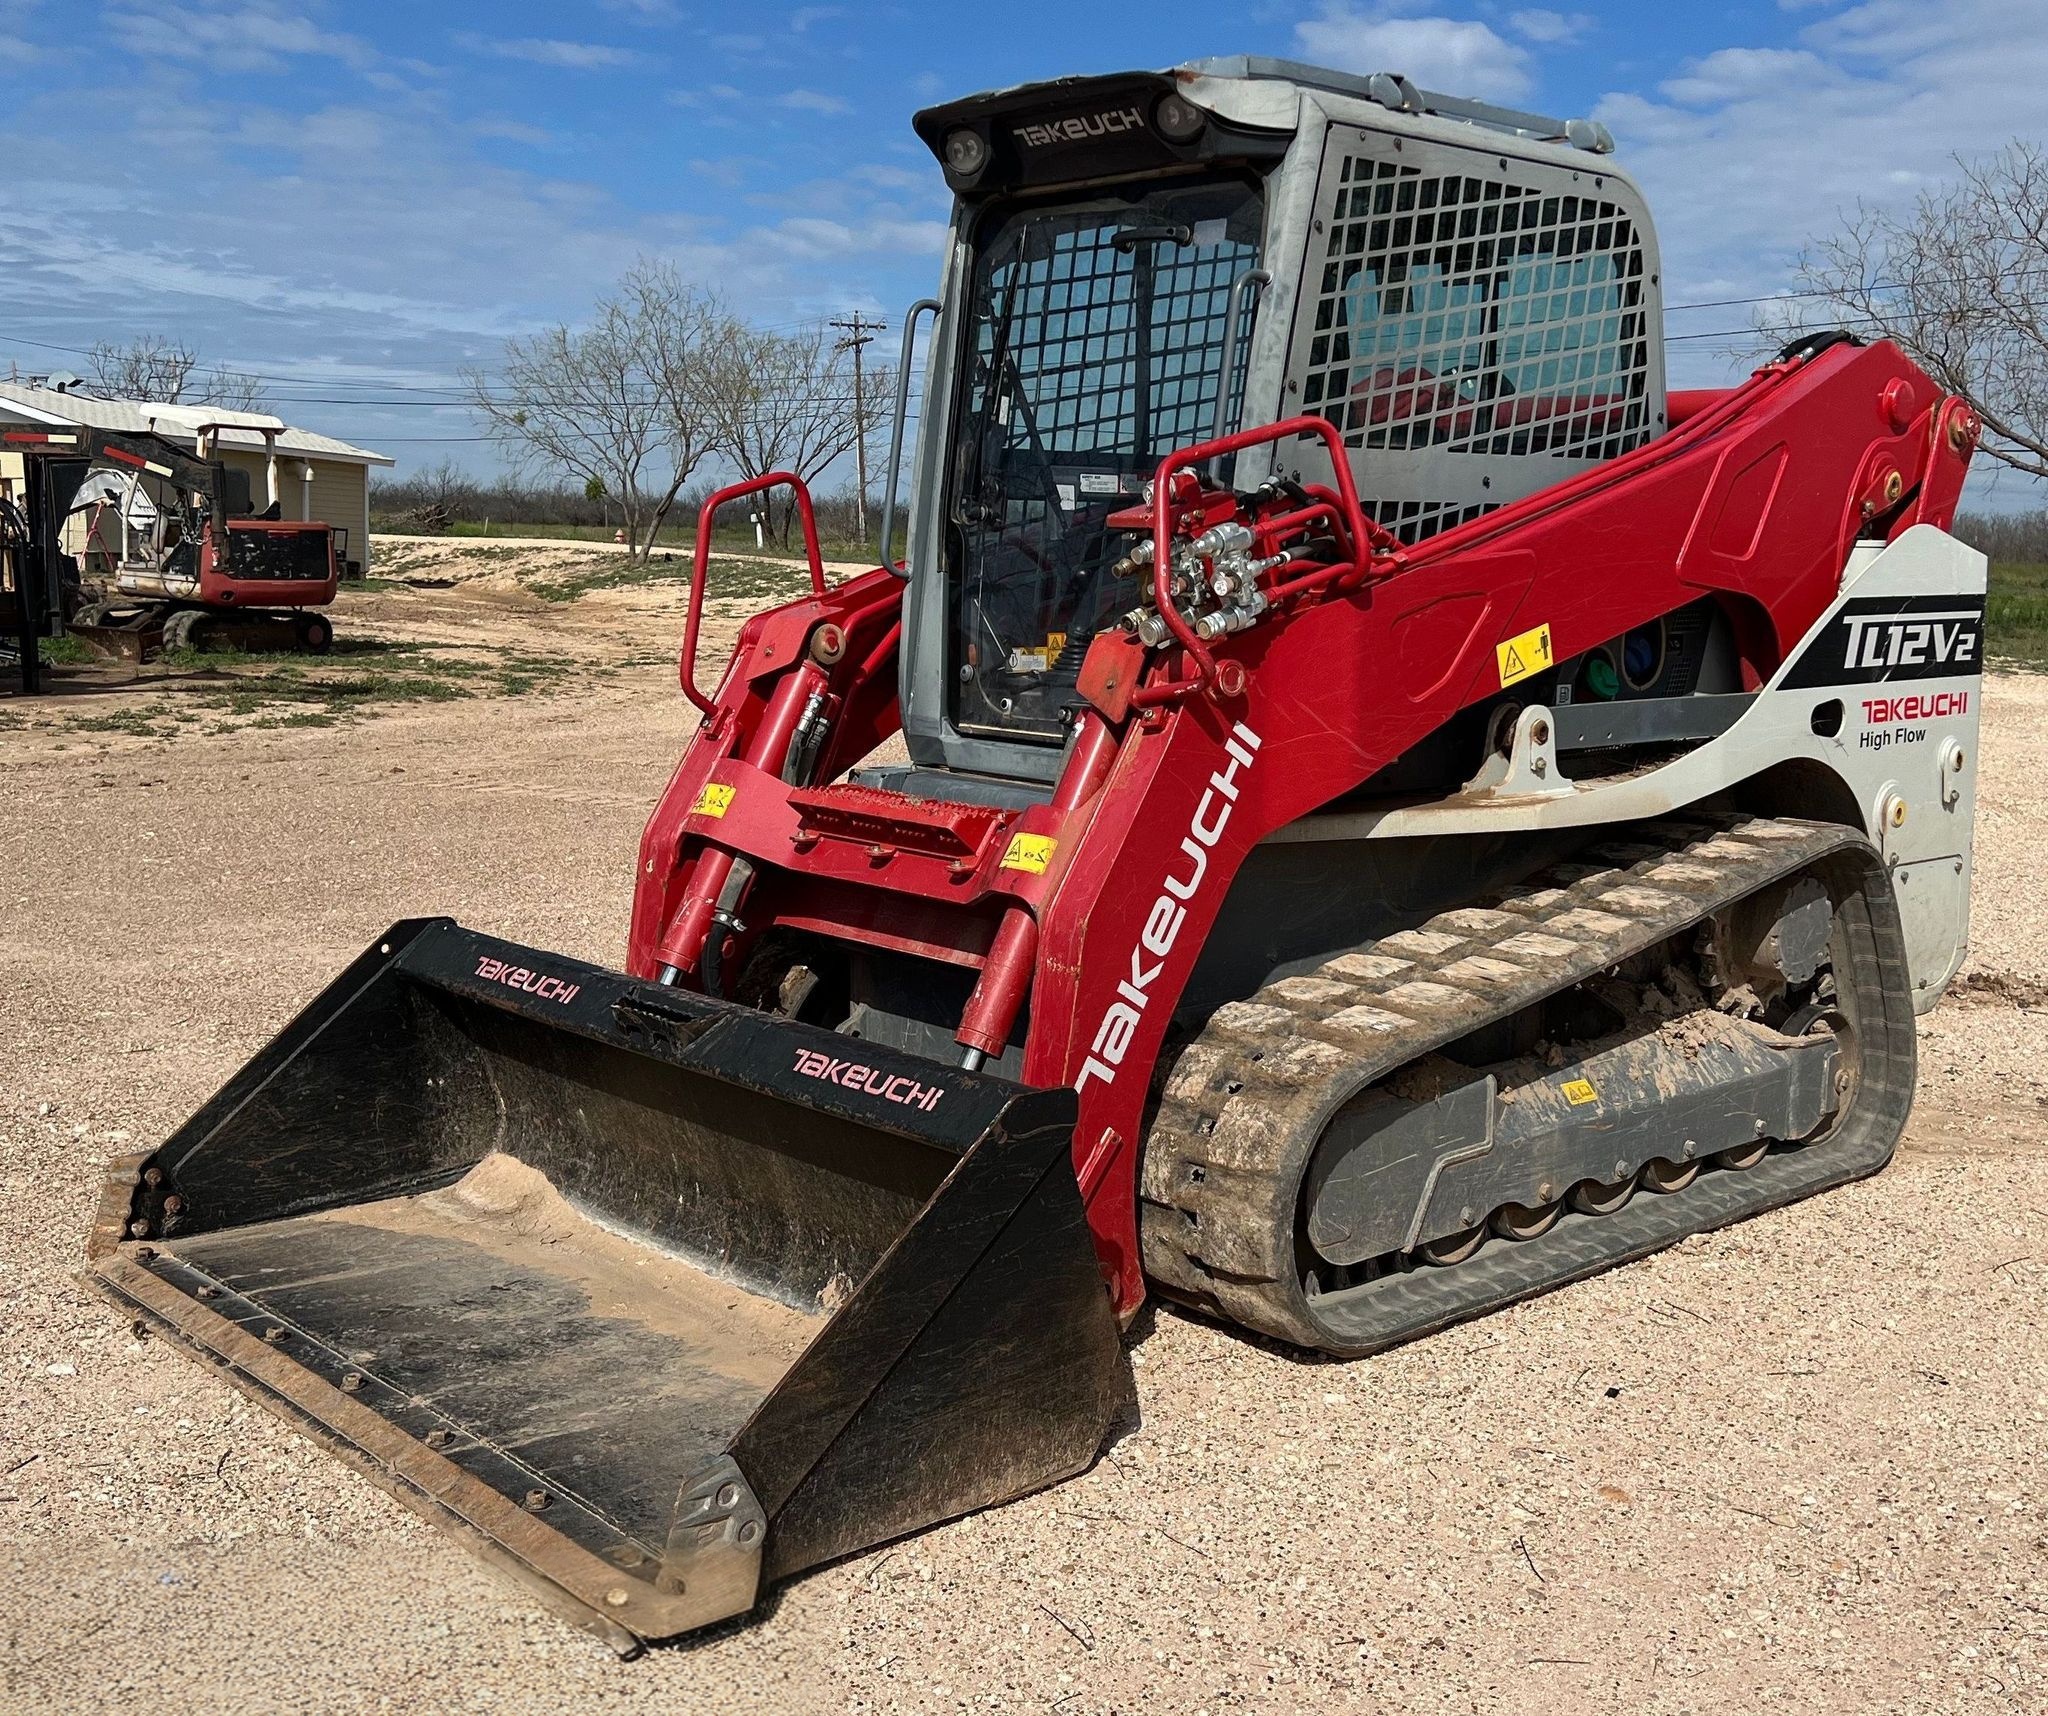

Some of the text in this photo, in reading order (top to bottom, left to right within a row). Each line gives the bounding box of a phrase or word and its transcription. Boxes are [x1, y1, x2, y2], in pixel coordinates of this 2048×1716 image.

[1842, 610, 1982, 670] TL12V2
[1859, 727, 1926, 751] High Flow
